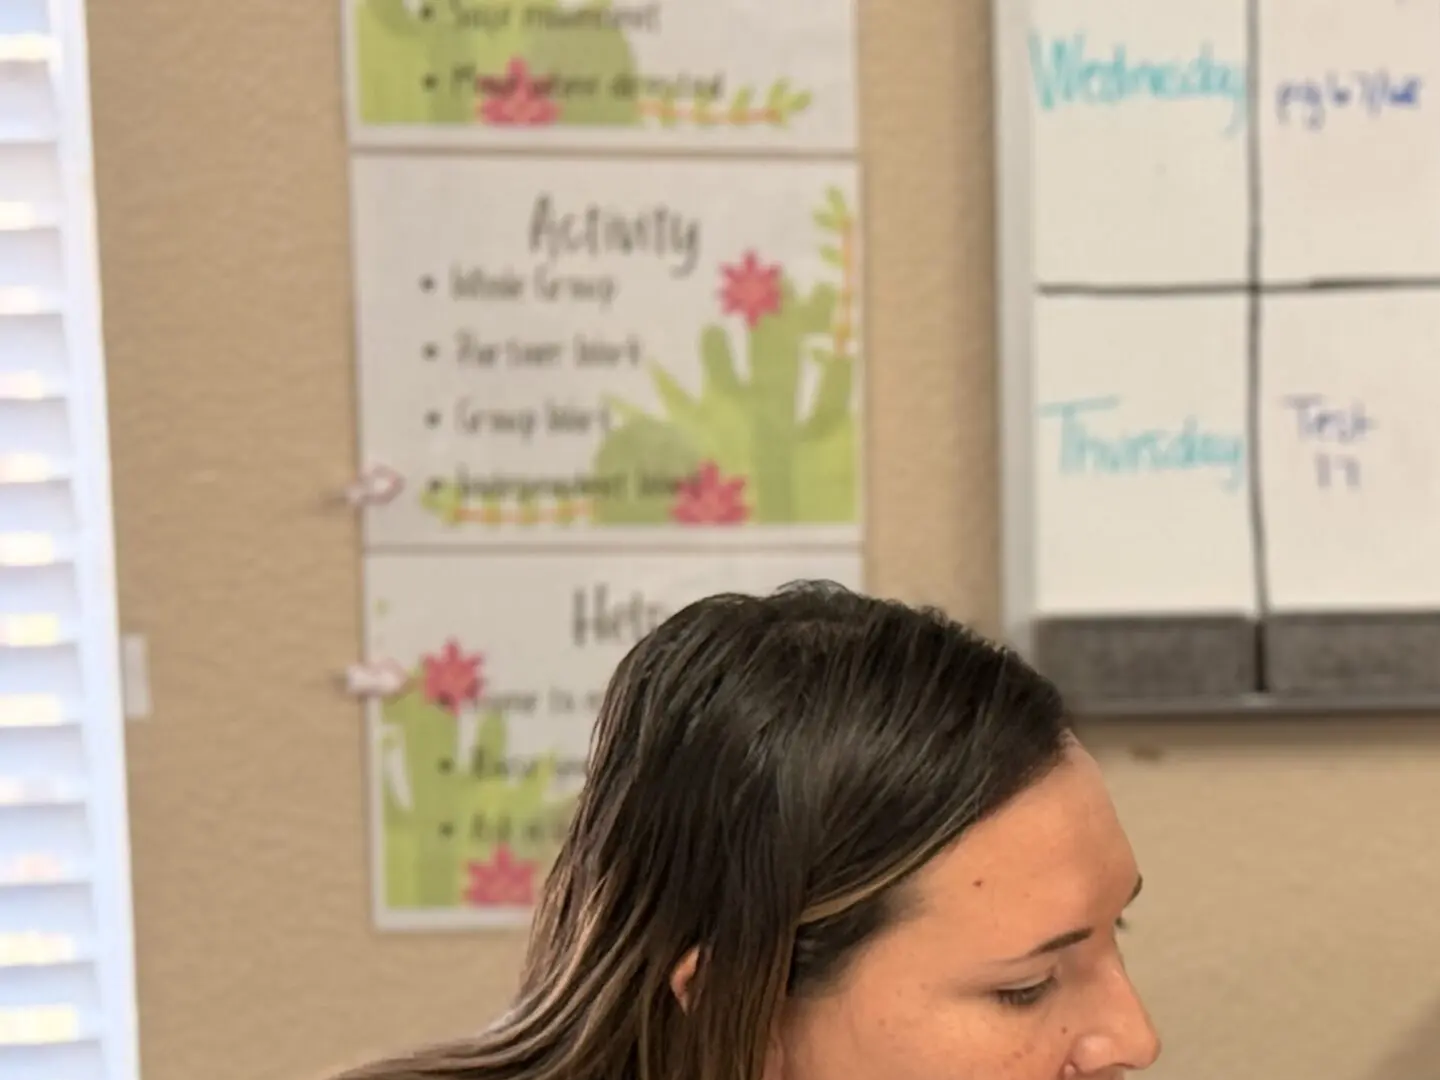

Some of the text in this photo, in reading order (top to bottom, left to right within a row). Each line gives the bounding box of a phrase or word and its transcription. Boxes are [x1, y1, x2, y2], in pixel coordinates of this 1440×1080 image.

[1029, 28, 1247, 138] Wednesday
[529, 194, 700, 278] Activity
[534, 268, 618, 308] Group
[1036, 395, 1247, 493] Thursday
[1284, 392, 1377, 443] Test
